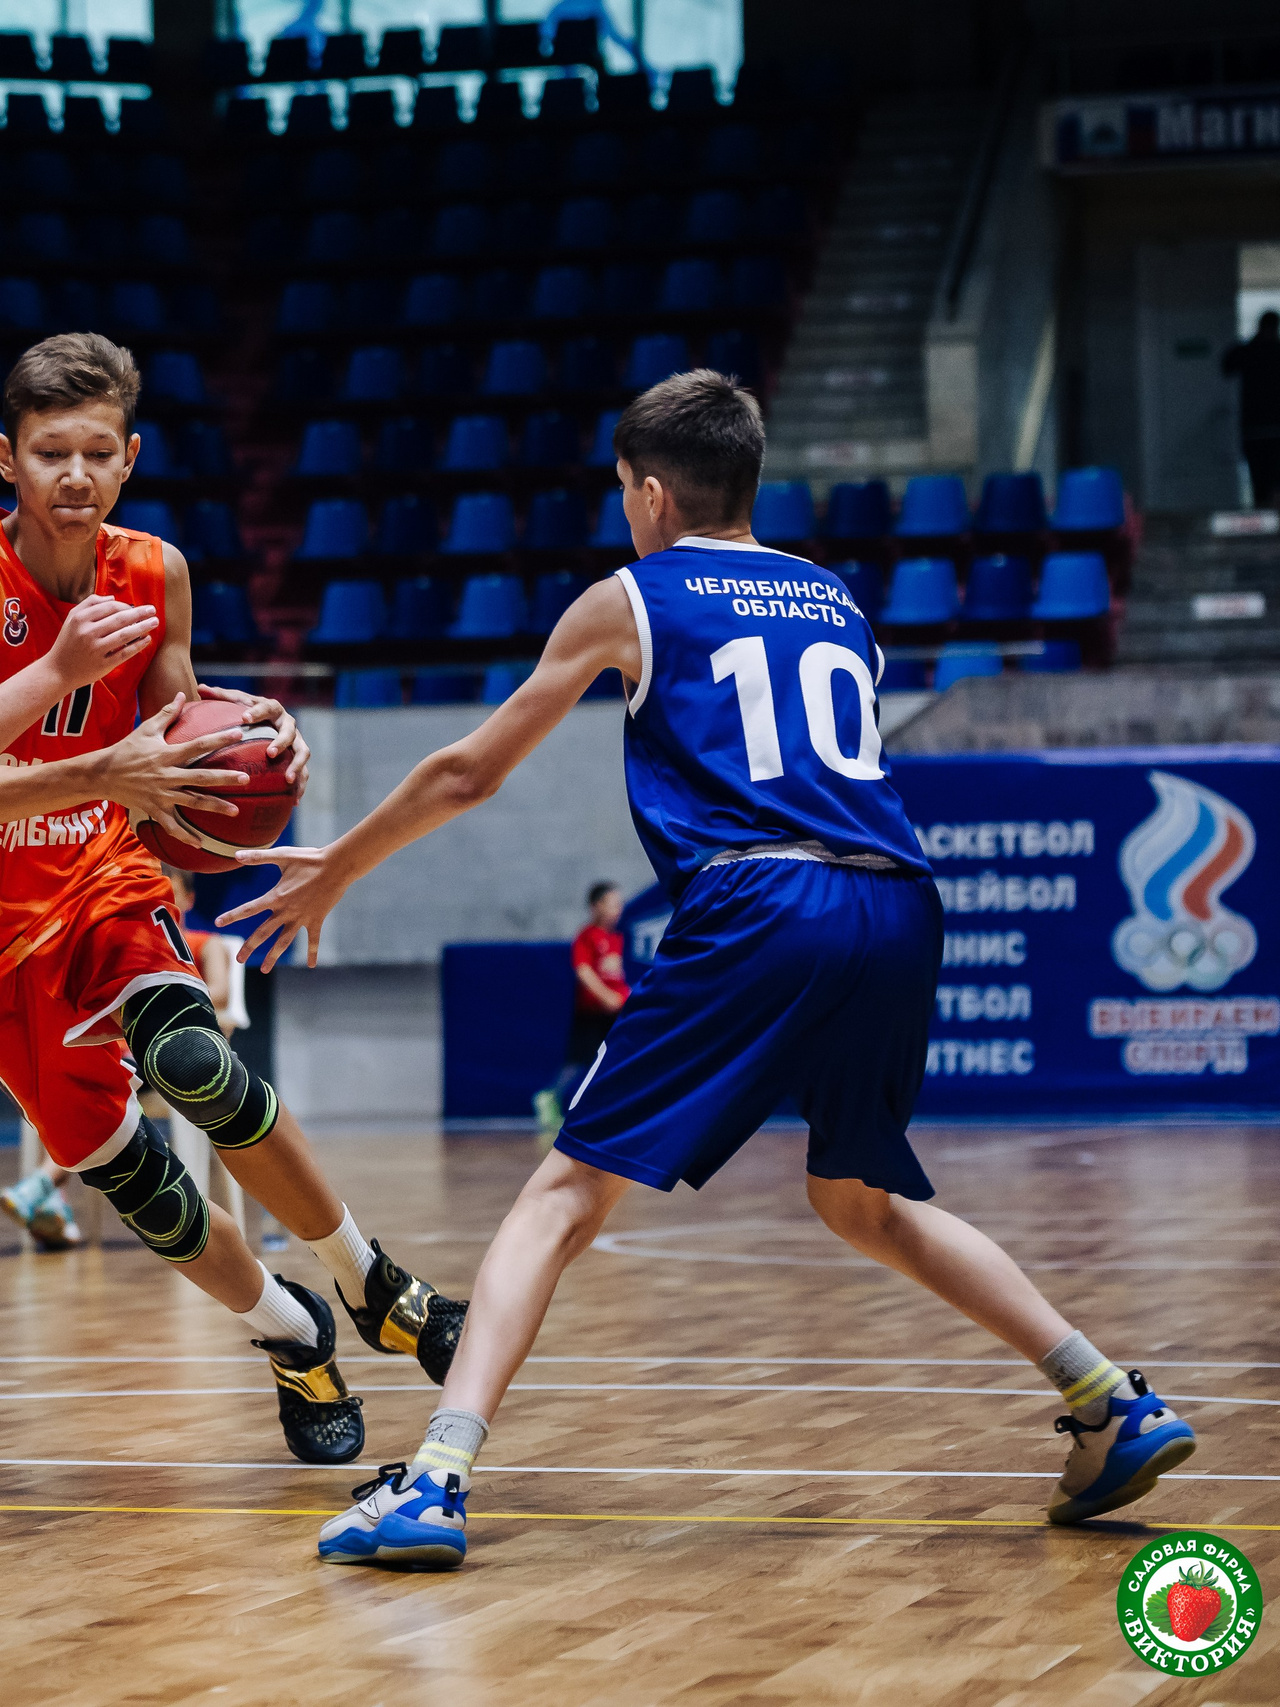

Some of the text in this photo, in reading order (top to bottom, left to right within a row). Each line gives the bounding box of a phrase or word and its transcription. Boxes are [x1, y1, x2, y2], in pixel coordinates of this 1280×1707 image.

[732, 598, 846, 627] ОБЛАСТЬ
[709, 635, 885, 783] 10
[150, 904, 195, 966] 1
[936, 985, 1033, 1022] ТБОЛ
[924, 1038, 1036, 1075] ИТНЕС
